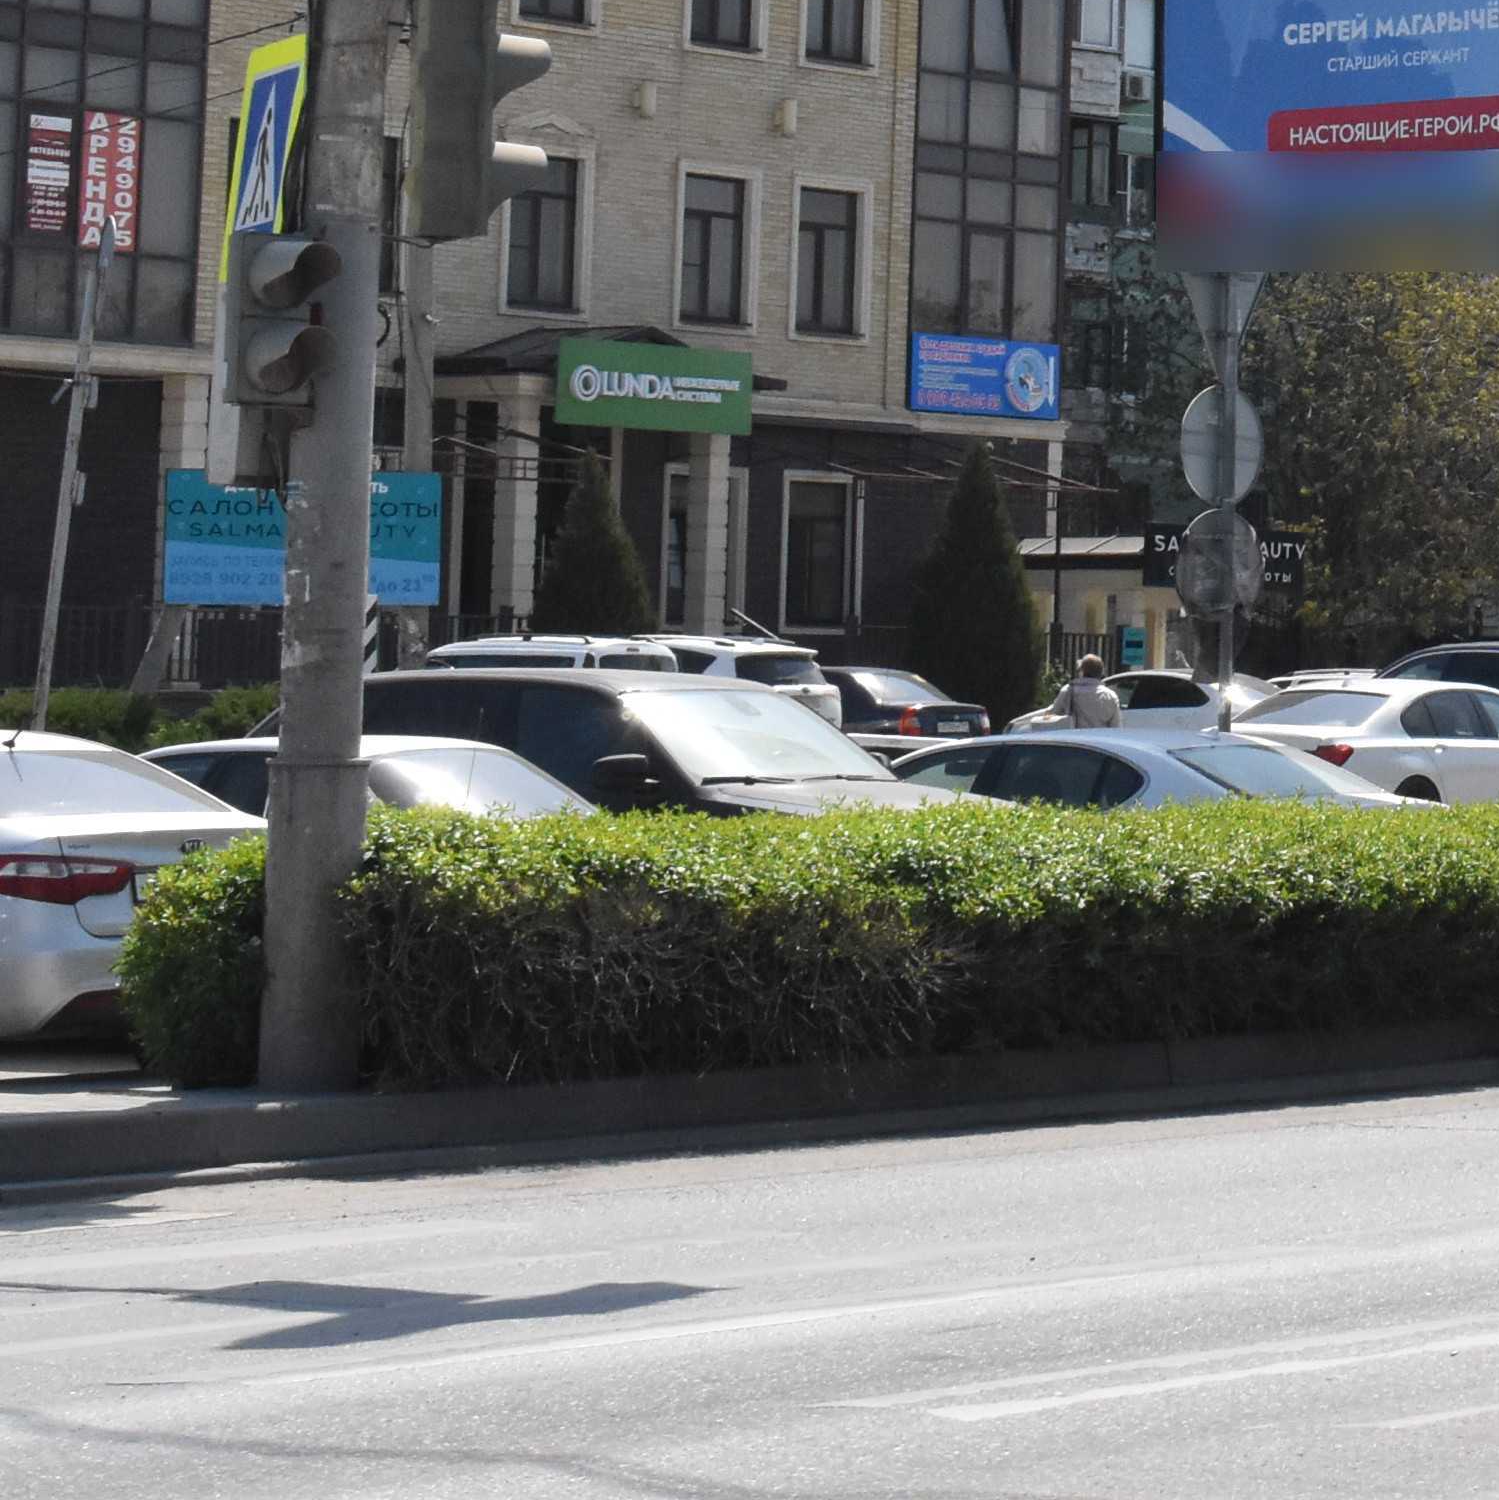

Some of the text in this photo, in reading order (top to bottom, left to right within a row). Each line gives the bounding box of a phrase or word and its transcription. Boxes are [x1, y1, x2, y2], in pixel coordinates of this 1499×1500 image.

[1282, 12, 1369, 46] СЕРГЕЙ
[1327, 47, 1471, 73] СТАРШИЙ СЕРЖАНТ
[81, 111, 110, 246] АРЕНДА
[113, 117, 137, 247] 2949075
[601, 370, 676, 400] LUNDA
[168, 499, 274, 516] САЛОН
[189, 522, 283, 537] SALMA
[1259, 541, 1306, 560] AUTY
